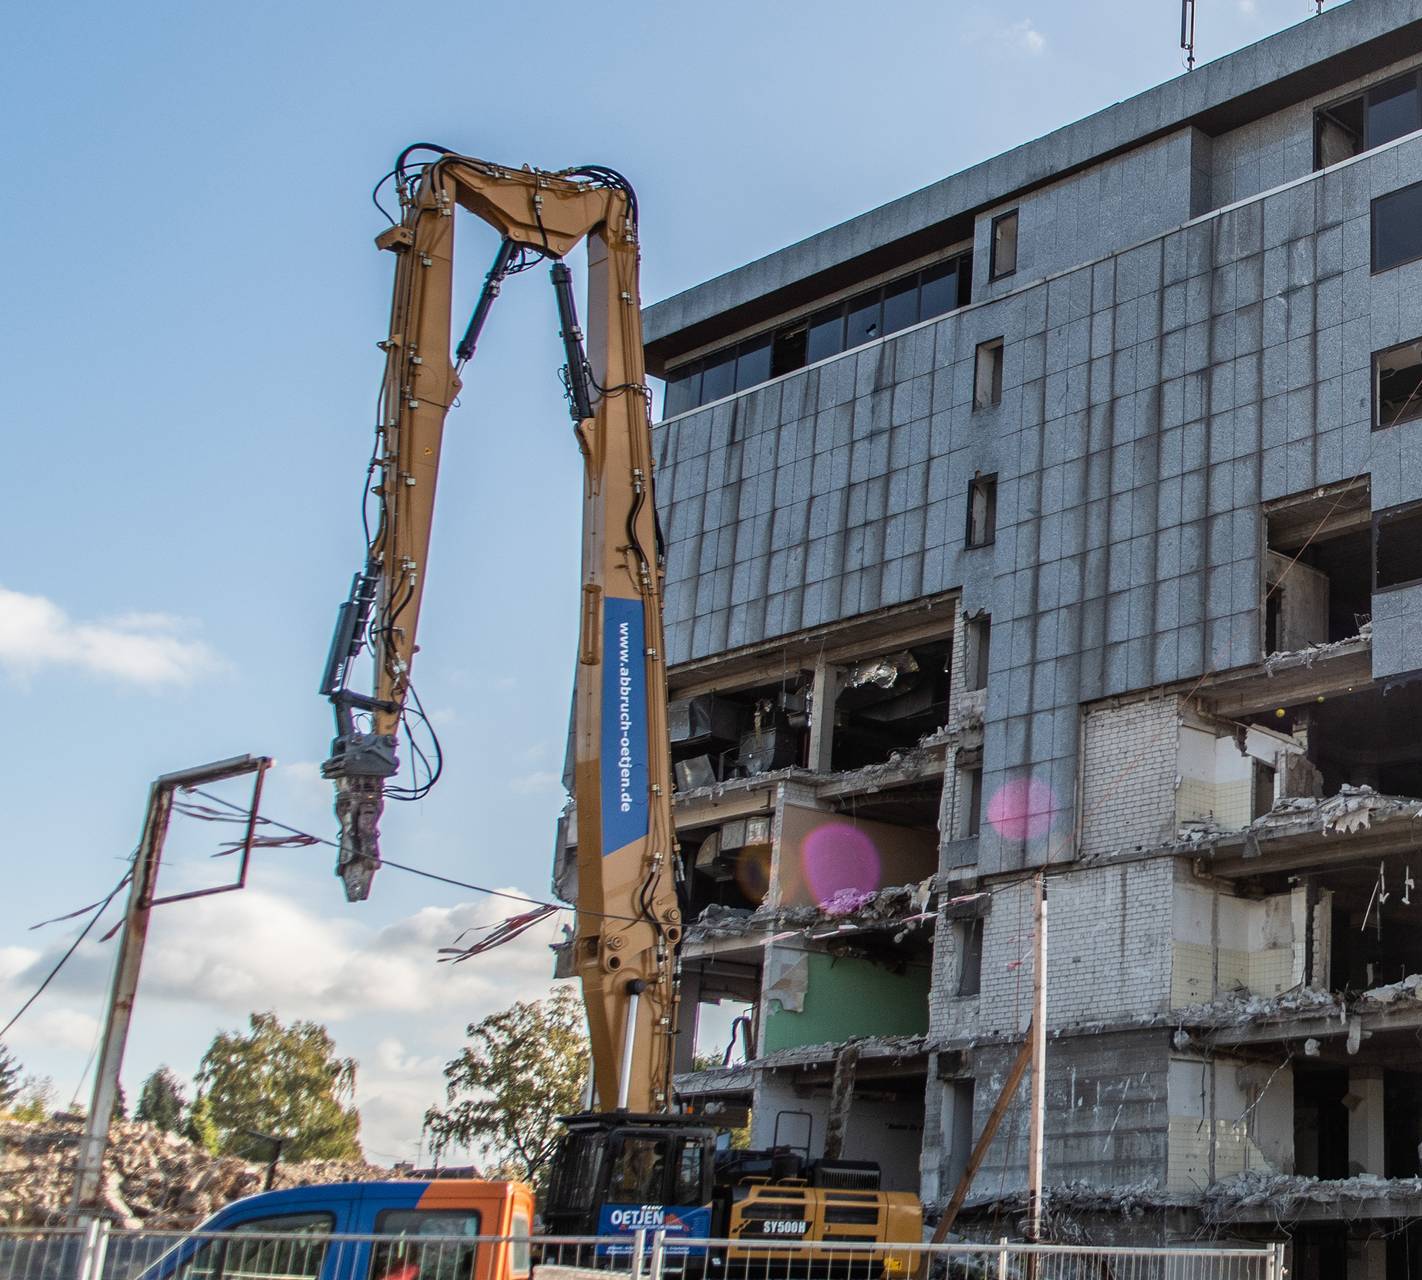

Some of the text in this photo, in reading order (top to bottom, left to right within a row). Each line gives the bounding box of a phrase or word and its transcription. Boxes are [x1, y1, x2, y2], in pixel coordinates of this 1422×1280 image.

[618, 621, 633, 813] www.abbruch-oetjen.de
[611, 1209, 665, 1225] OETJEN
[763, 1220, 807, 1233] SY500H
